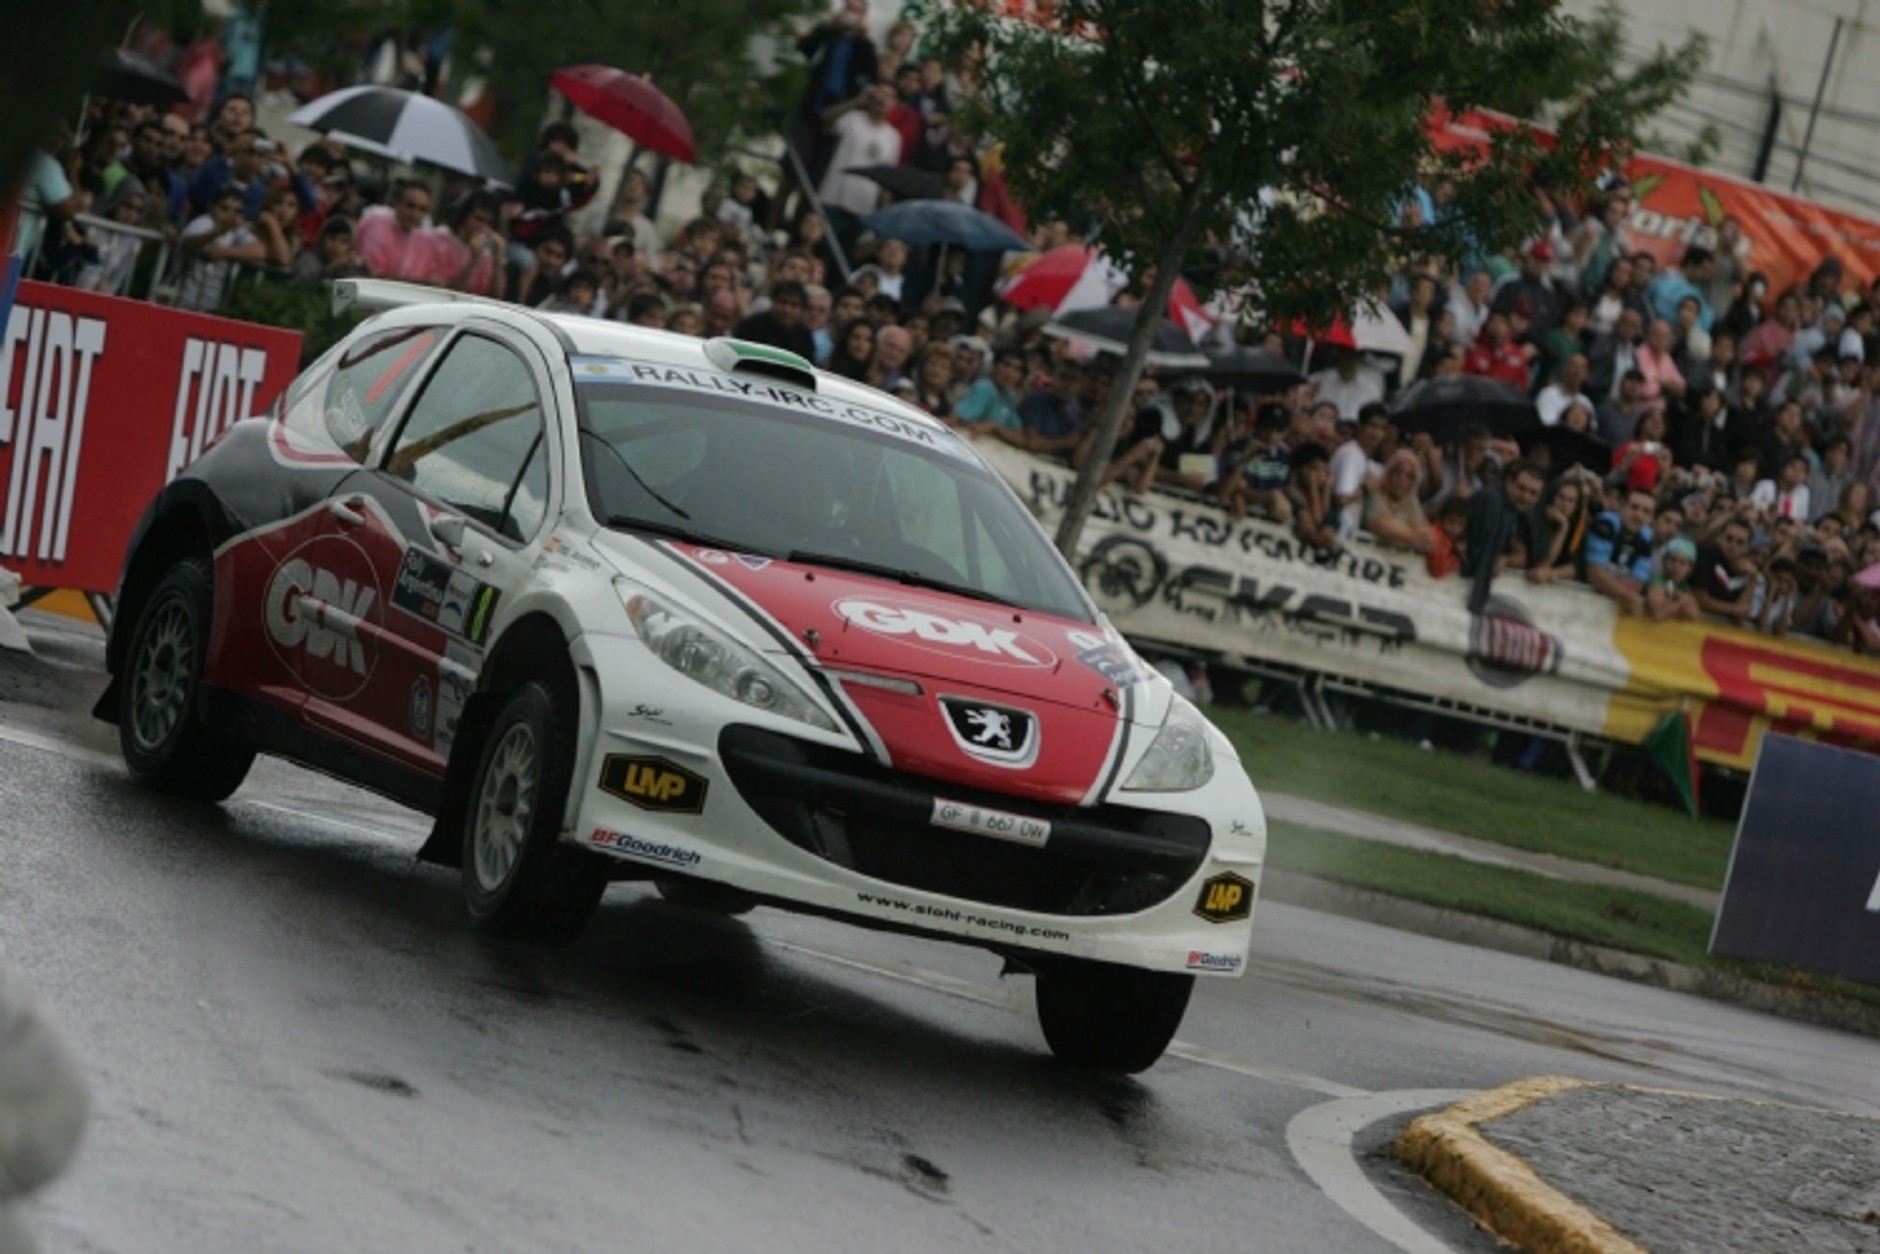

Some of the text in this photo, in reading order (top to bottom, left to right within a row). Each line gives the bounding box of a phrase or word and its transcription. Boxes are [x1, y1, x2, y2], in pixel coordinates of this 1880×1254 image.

[0, 304, 107, 561] FIAT
[631, 364, 936, 446] RALLY-IRC.COM
[266, 558, 377, 677] GDK
[837, 601, 1041, 664] GDK
[624, 763, 686, 801] LMP
[591, 828, 702, 865] BFGoodrich
[1205, 883, 1242, 912] LMP
